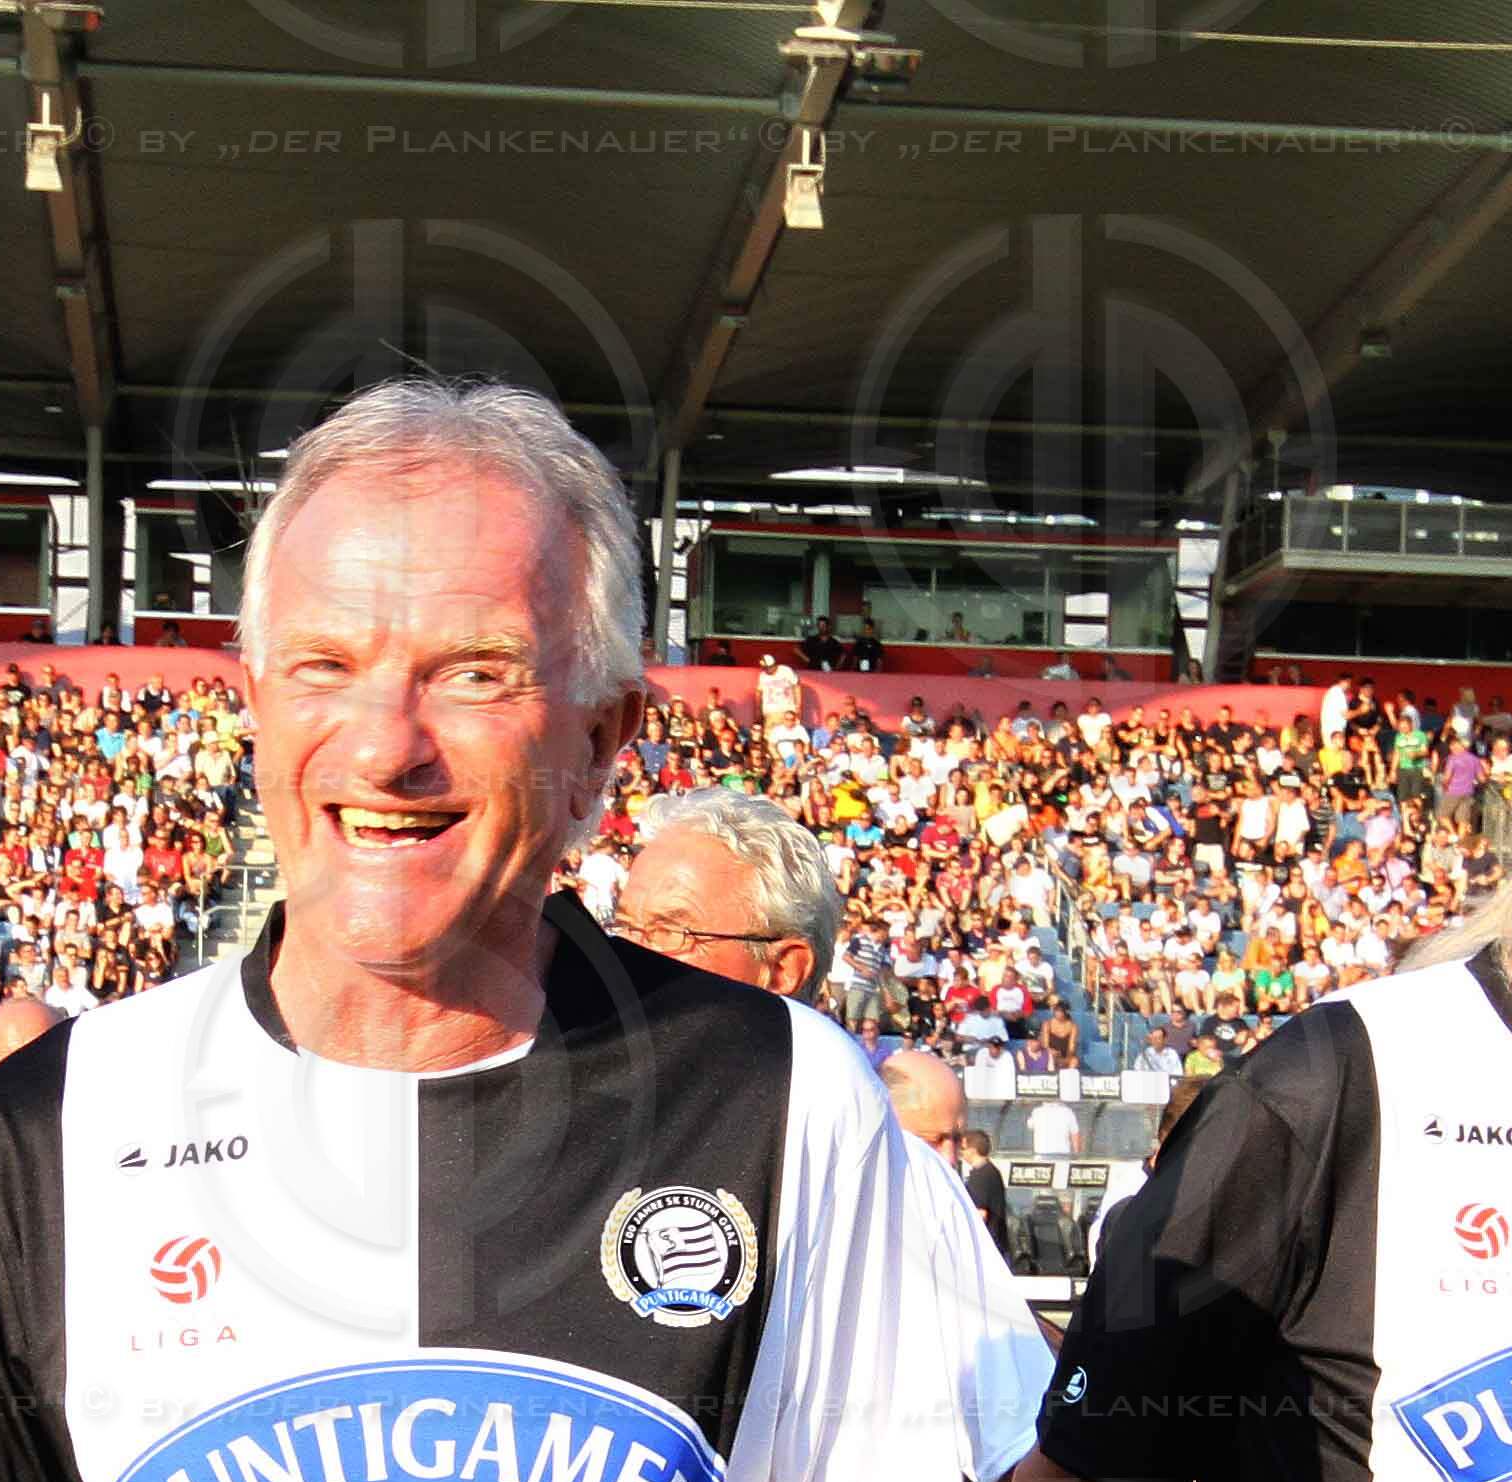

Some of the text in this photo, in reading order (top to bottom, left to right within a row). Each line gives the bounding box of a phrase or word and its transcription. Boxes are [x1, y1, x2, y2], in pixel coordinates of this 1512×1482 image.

[163, 1134, 249, 1169] JAKO
[683, 1196, 718, 1218] STURM
[639, 1290, 726, 1312] PUNTIGAMER
[130, 1324, 238, 1352] LIGA
